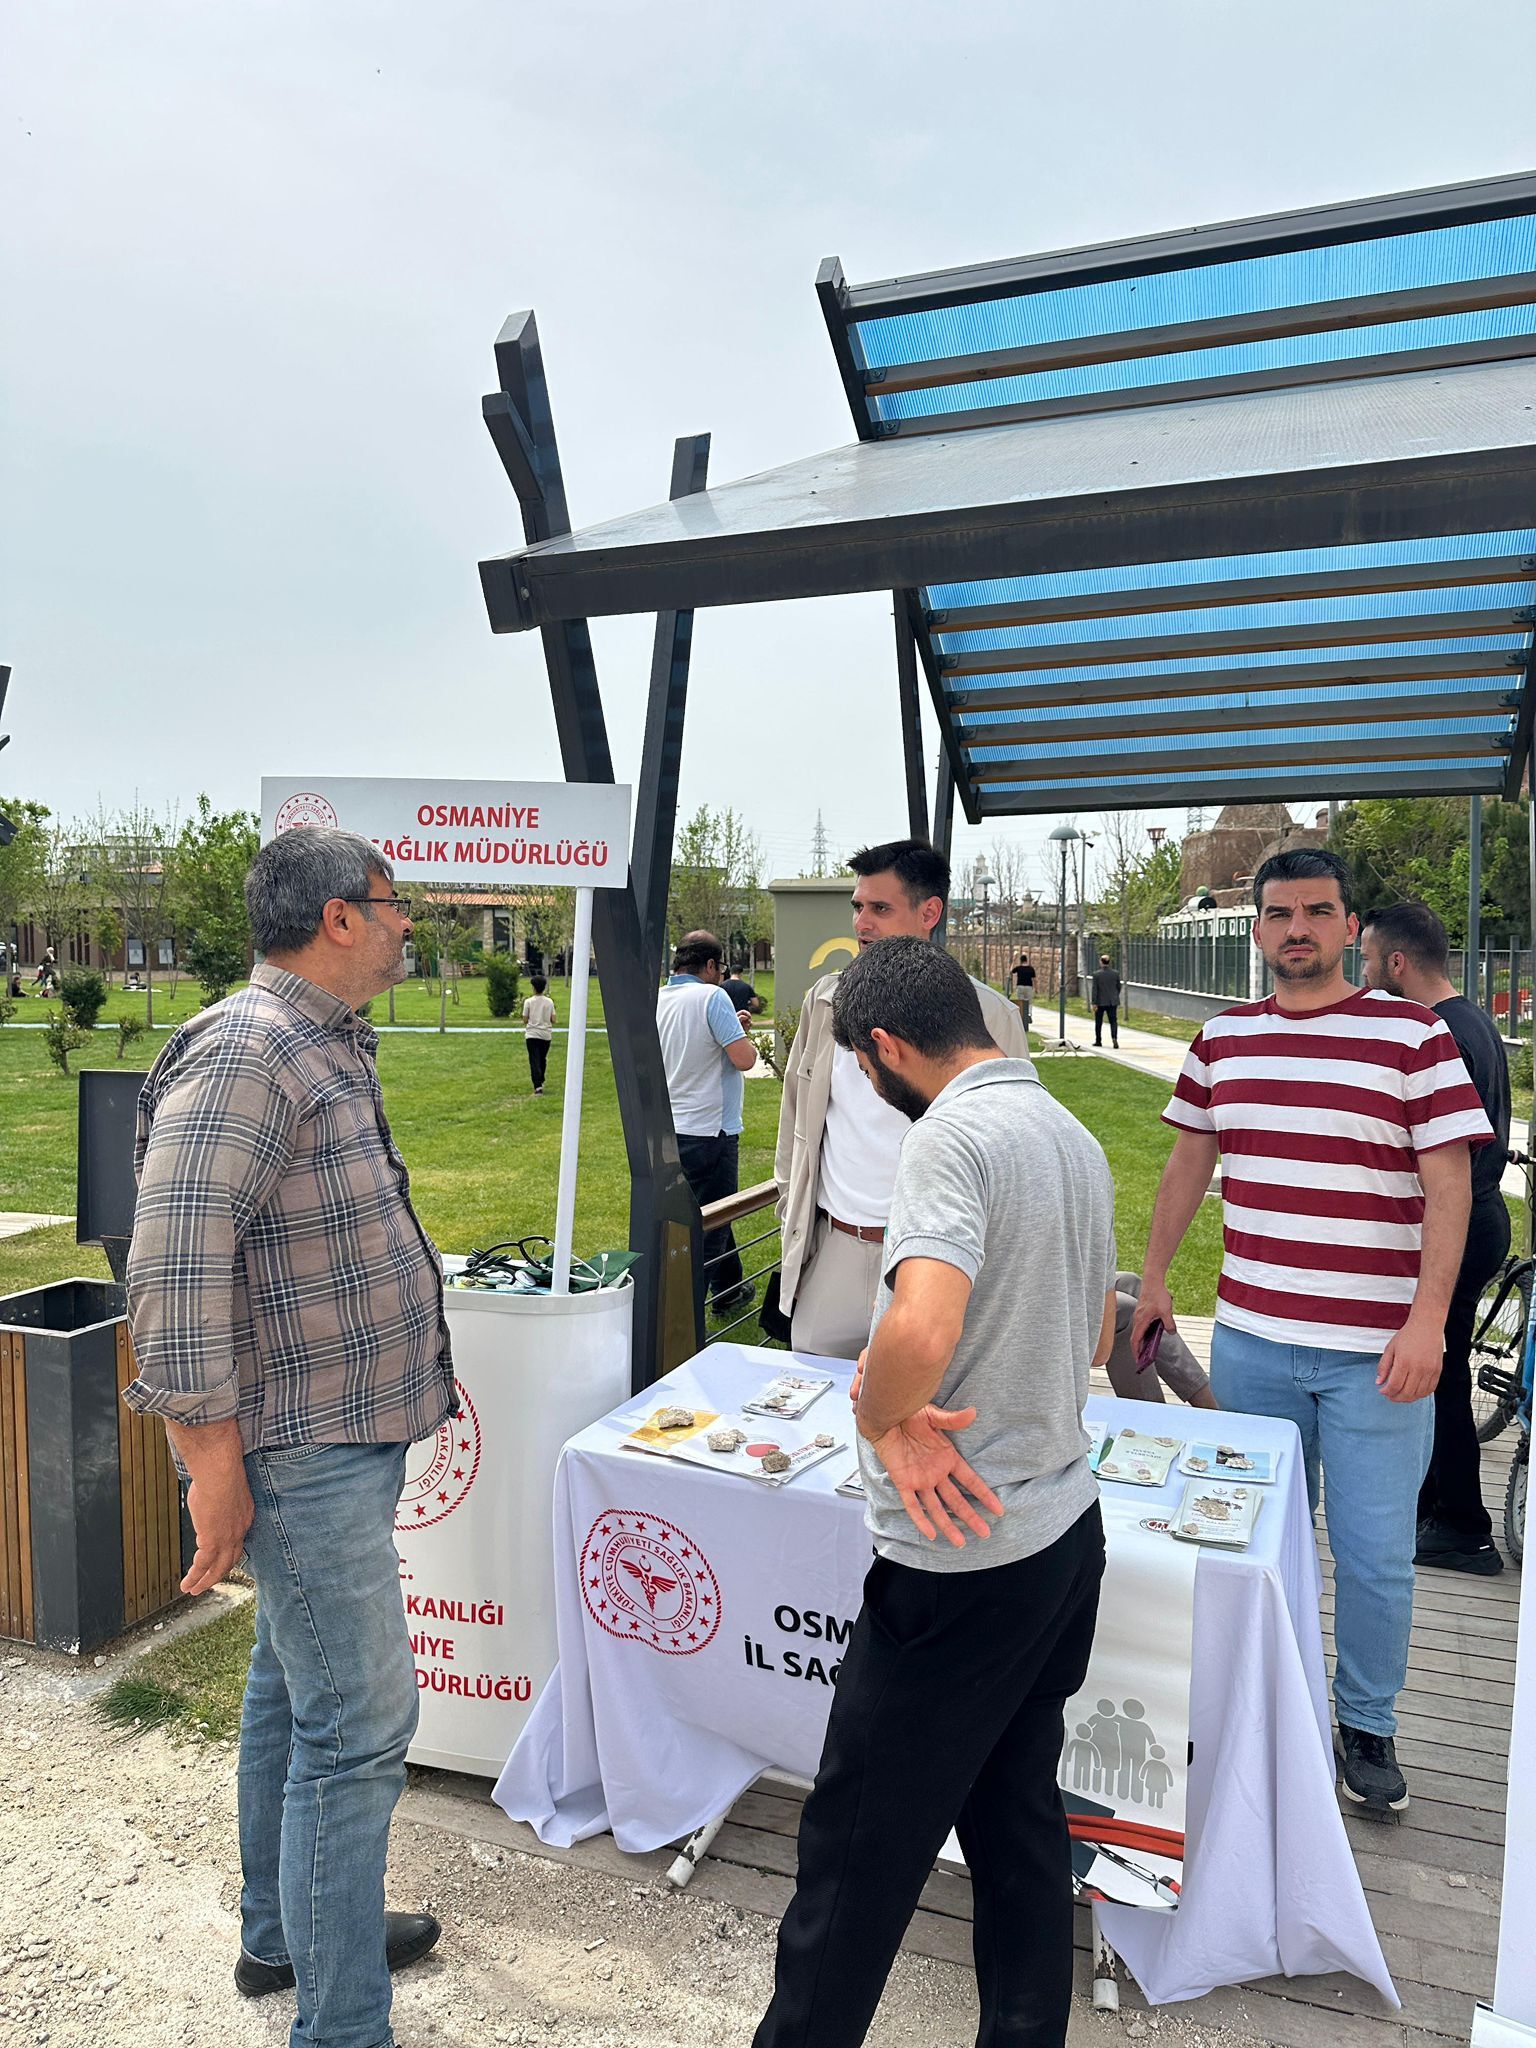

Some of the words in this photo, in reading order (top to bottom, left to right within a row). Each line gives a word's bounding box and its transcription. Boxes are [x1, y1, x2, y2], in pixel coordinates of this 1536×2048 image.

[416, 802, 540, 829] OSMANİYE
[371, 834, 449, 862] AĞLIK
[454, 837, 609, 867] MÜDÜRLÜĞÜ
[418, 1426, 449, 1491] BAKANLIĞI
[605, 1535, 651, 1571] CUMHURİYETİ
[654, 1546, 687, 1580] SAĞLIK
[405, 1594, 504, 1626] KANLIĞI
[605, 1574, 636, 1612] TÜRKİYE
[670, 1581, 694, 1629] BAKANLIĞI
[774, 1604, 855, 1645] OSM
[408, 1631, 455, 1660] NİYE
[744, 1634, 775, 1672] İL
[415, 1667, 532, 1702] DÜRLÜĞÜ
